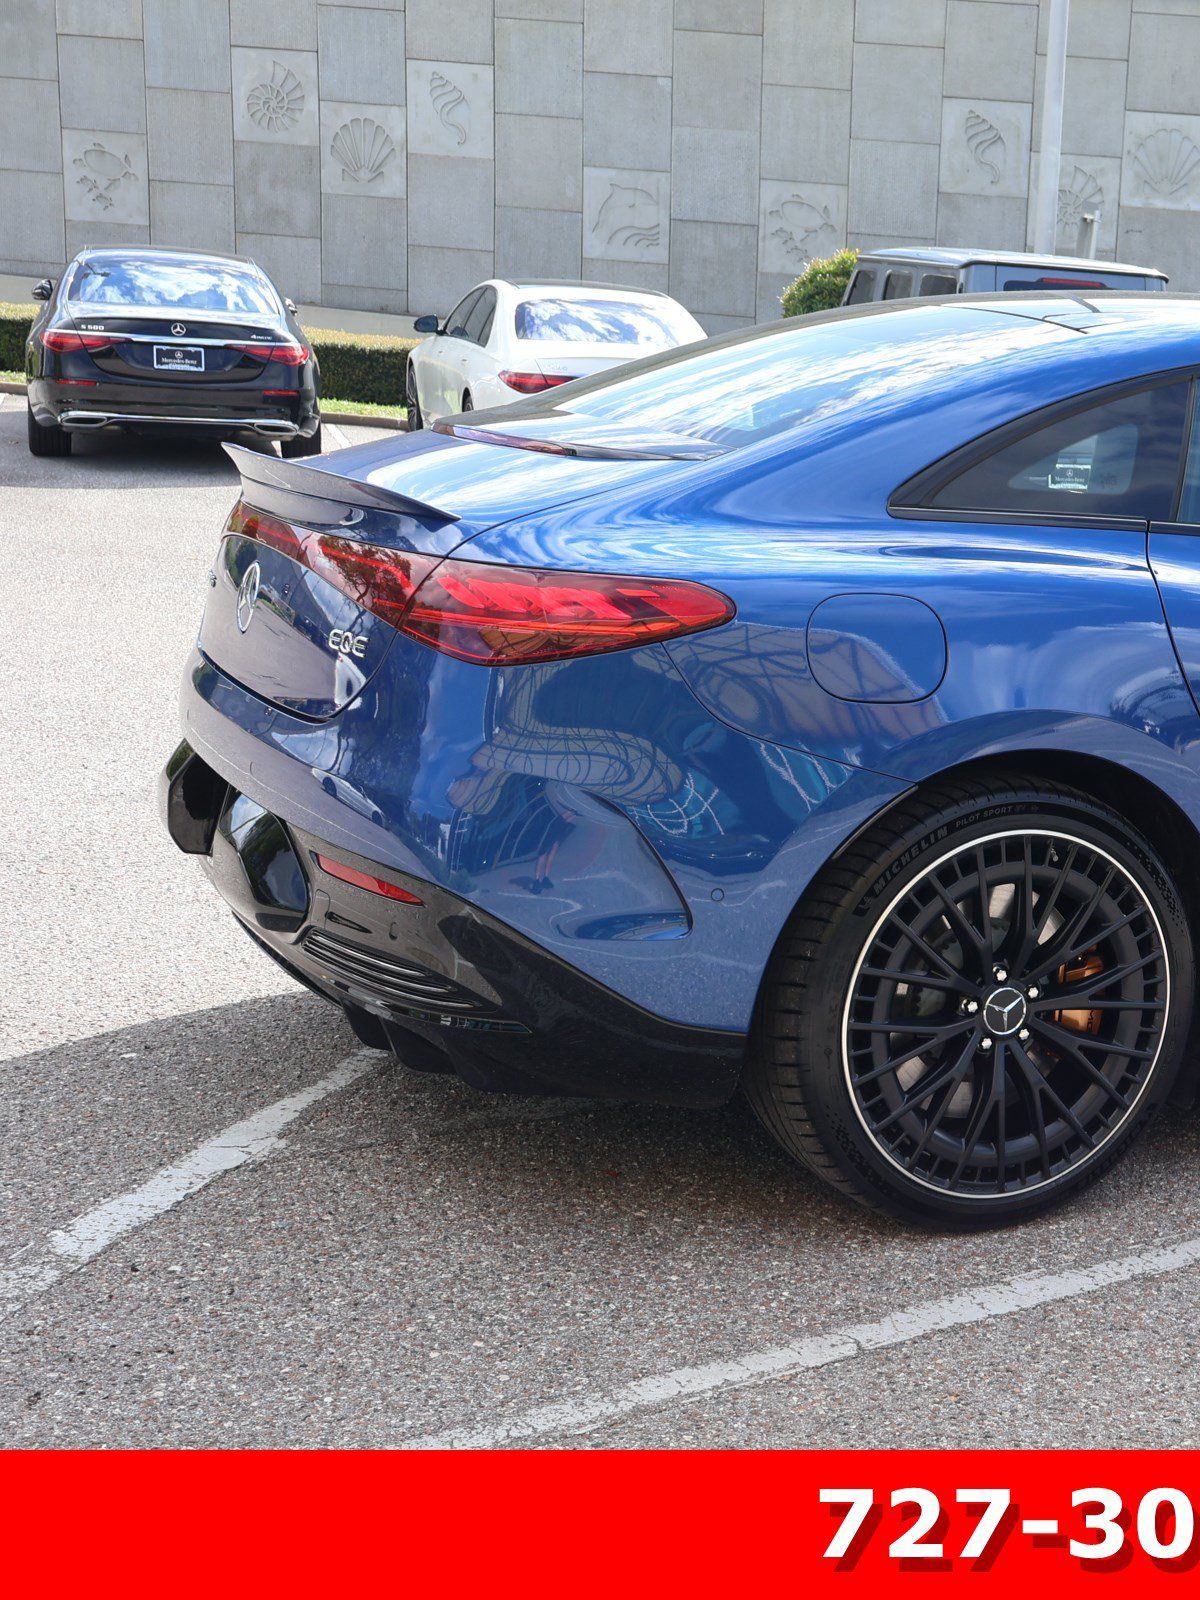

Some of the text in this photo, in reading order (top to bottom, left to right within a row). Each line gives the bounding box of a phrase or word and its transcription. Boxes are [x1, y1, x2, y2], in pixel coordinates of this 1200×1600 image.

[161, 357, 198, 365] Mercedes-Benz
[328, 628, 370, 658] EQE
[873, 825, 950, 896] MICHELIN
[955, 812, 981, 829] PILOT
[983, 804, 1013, 819] SPORT
